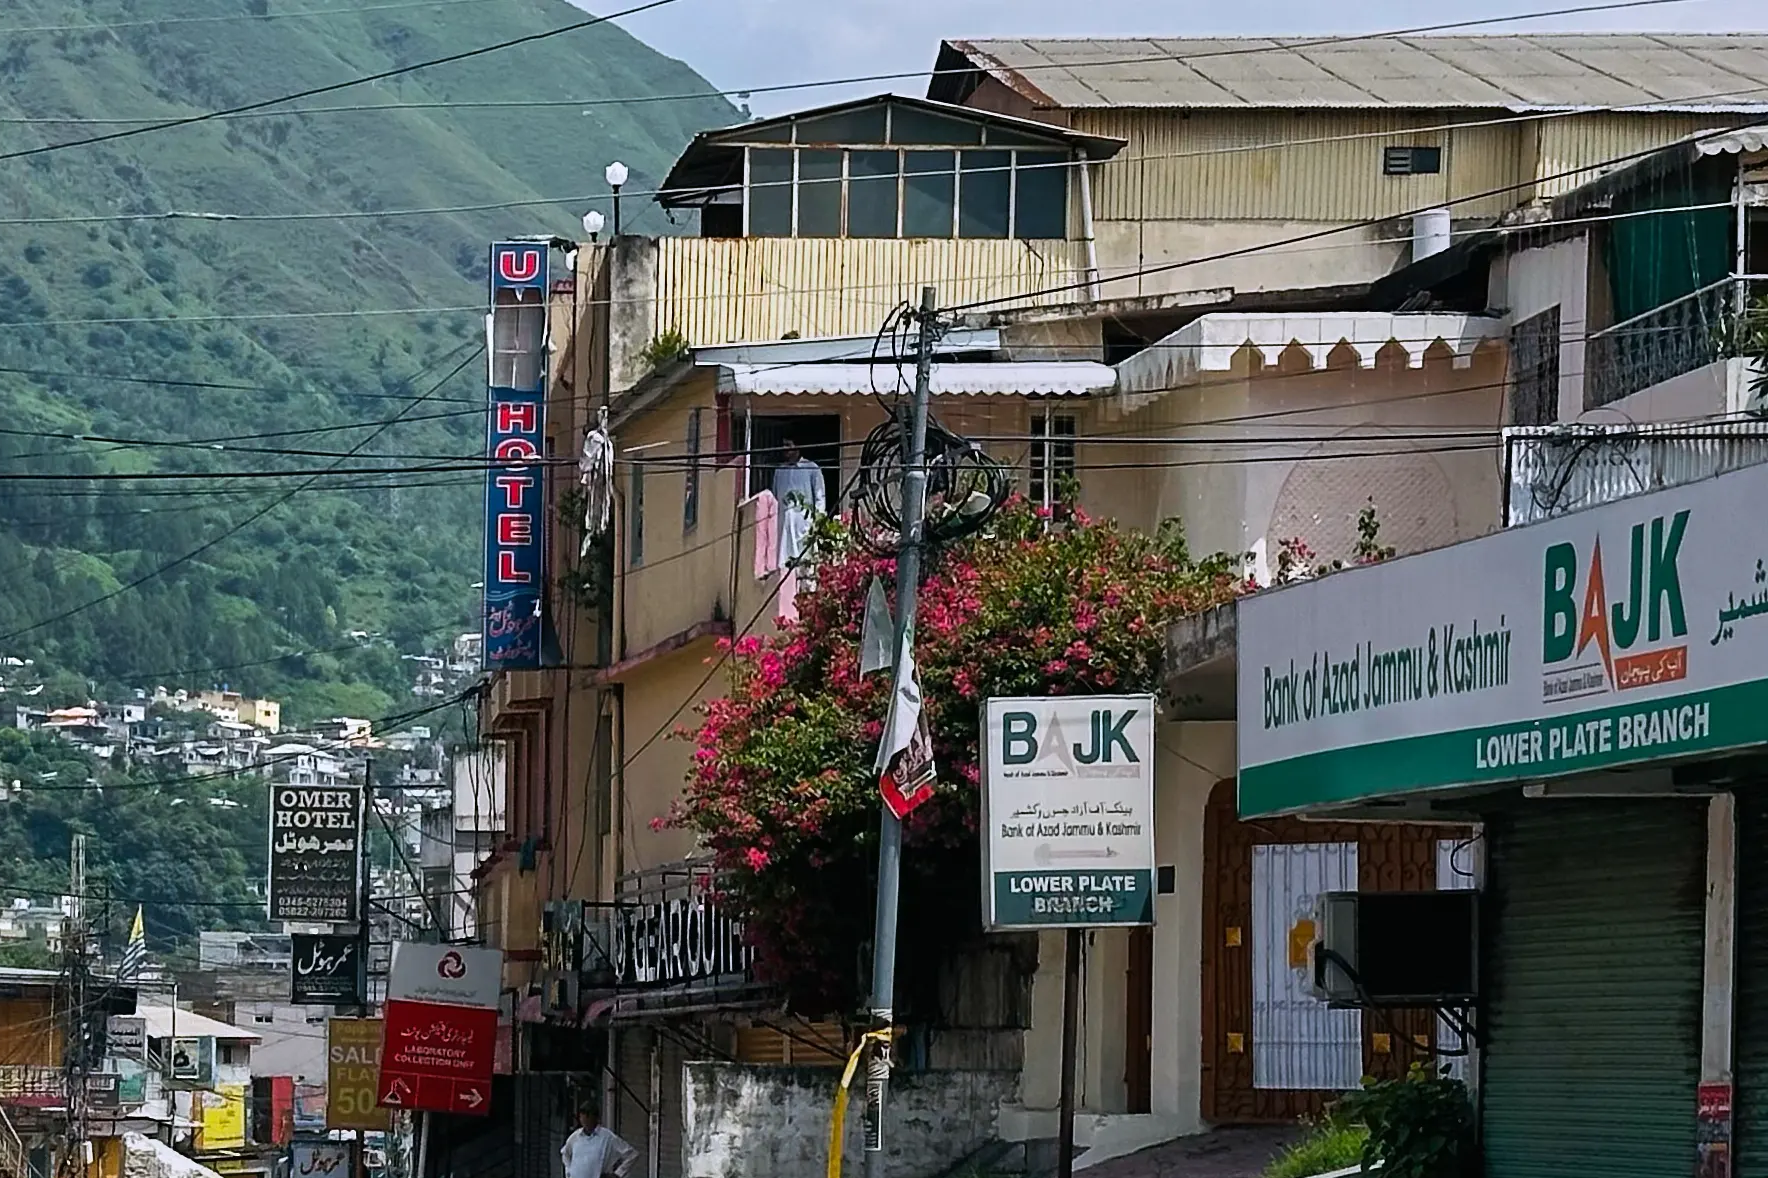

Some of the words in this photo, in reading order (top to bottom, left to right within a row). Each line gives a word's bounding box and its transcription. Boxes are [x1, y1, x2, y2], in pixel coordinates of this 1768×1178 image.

[494, 401, 538, 584] HOTEL
[1542, 509, 1691, 692] BAJK
[1264, 659, 1299, 730] Bank
[1302, 652, 1318, 721] of
[1320, 644, 1360, 716] Azad
[1364, 635, 1422, 709] Jammu
[1428, 627, 1438, 693] &
[1444, 615, 1511, 692] Kashmir
[1002, 709, 1141, 775] BAJK
[1476, 730, 1544, 769] LOWER
[1549, 719, 1612, 761] PLATE
[1618, 702, 1710, 751] BRANCH
[280, 790, 353, 809] OMER
[276, 810, 356, 829] HOTEL
[1002, 823, 1023, 838] Bank
[1026, 823, 1035, 837] of
[1037, 822, 1060, 837] Azad
[1062, 822, 1096, 837] Jammu
[1097, 821, 1104, 836] &
[1106, 820, 1141, 837] Kashmir
[1010, 876, 1074, 894] LOWER
[1079, 875, 1136, 893] PLATE
[394, 1053, 451, 1067] COLLECTION
[404, 1045, 467, 1059] LABORATORY
